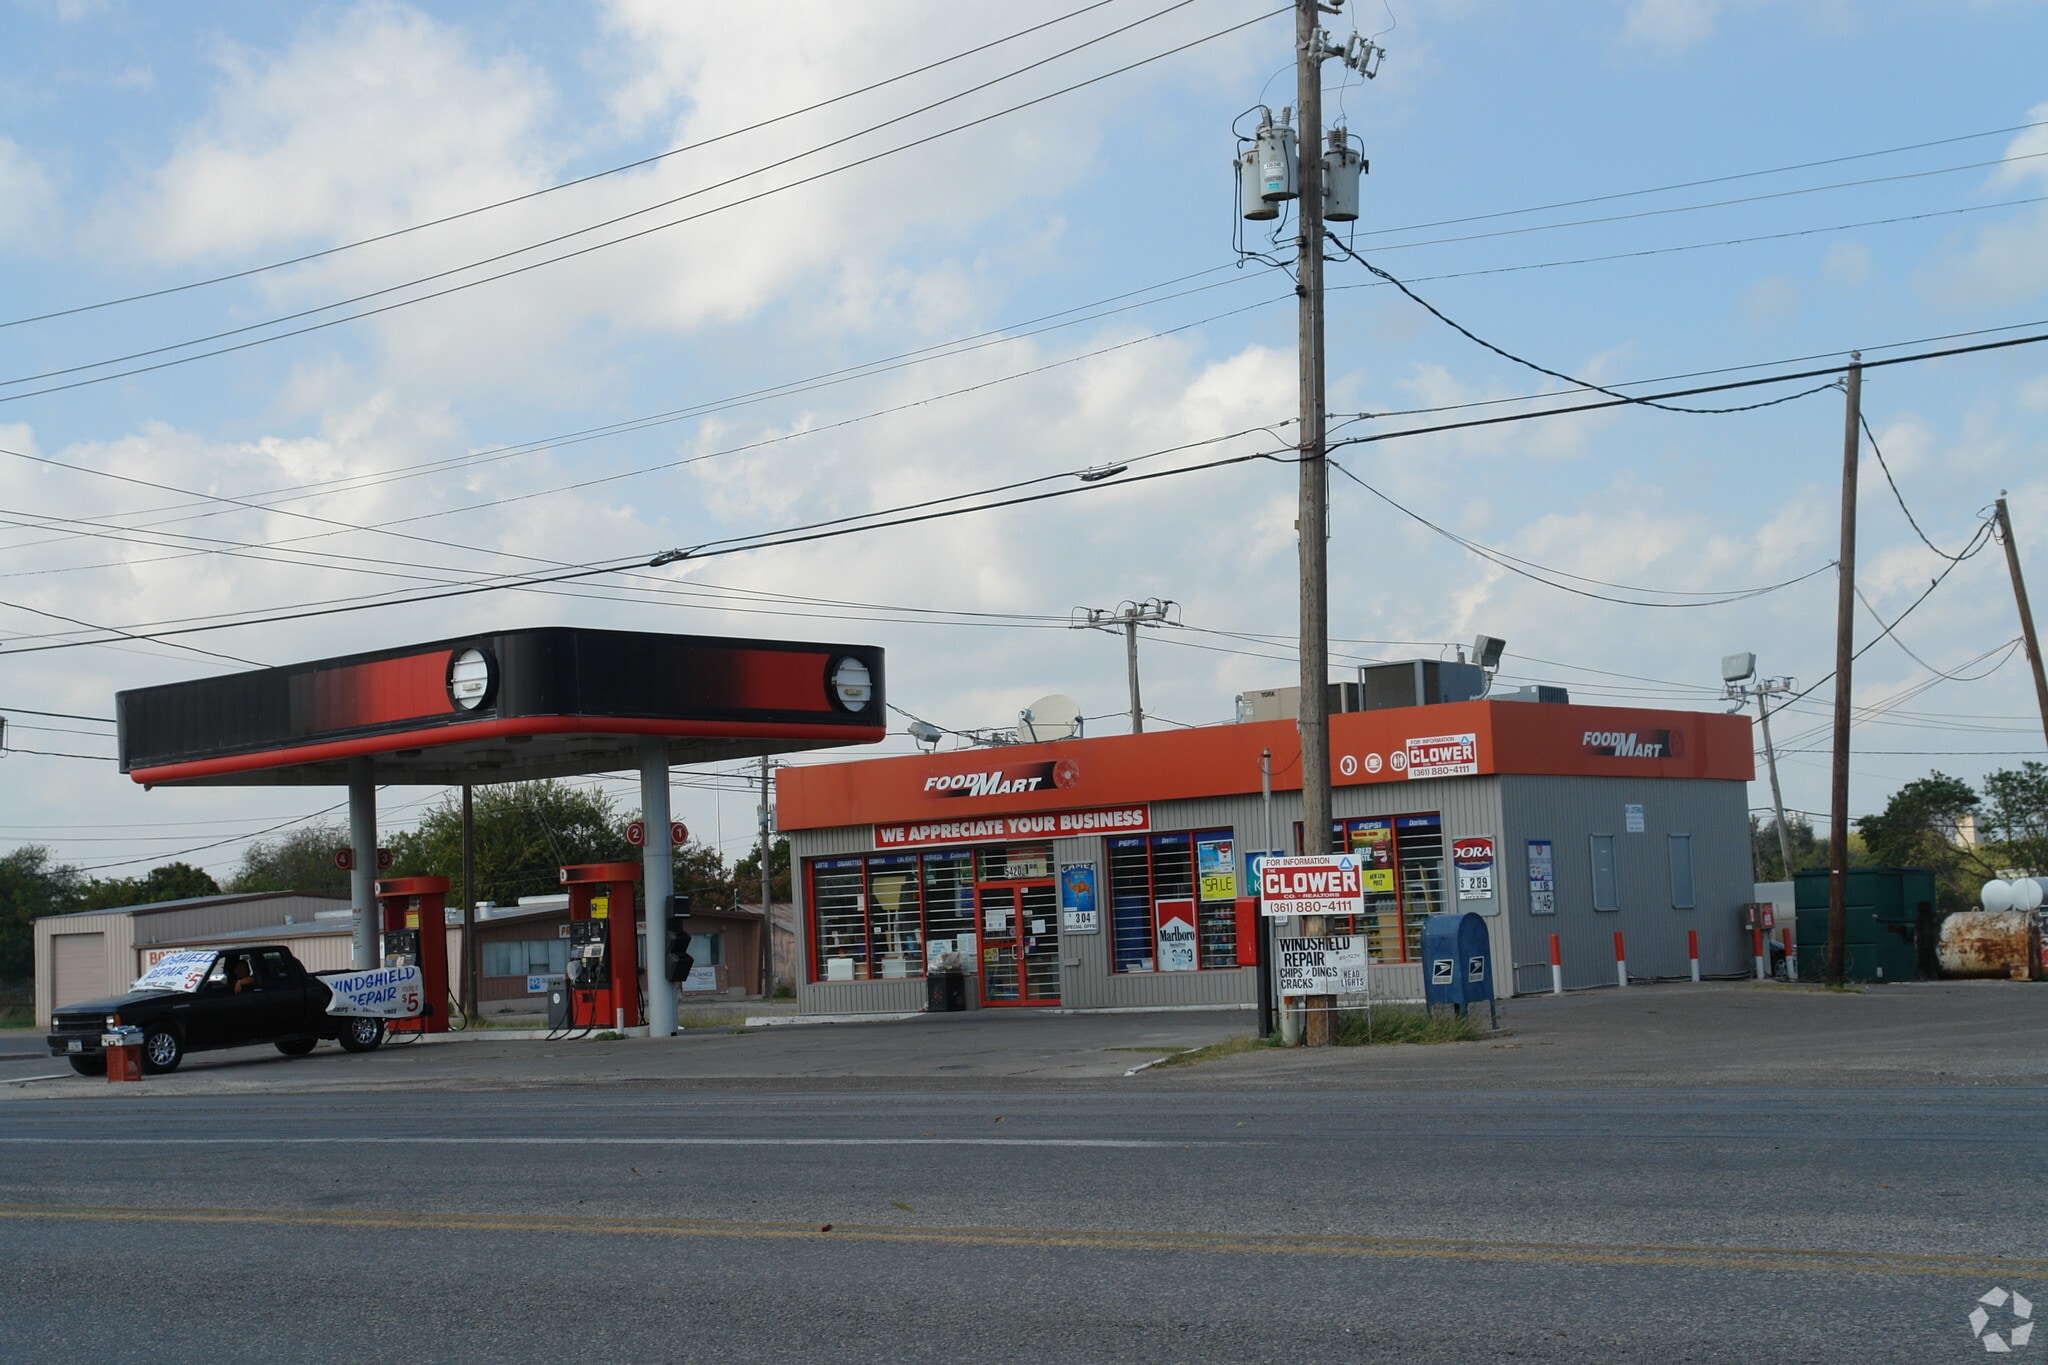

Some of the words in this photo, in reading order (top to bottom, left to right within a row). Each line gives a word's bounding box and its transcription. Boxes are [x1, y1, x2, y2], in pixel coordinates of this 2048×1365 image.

[1410, 745, 1474, 764] CLOWER
[1413, 768, 1430, 777] (361)
[1431, 765, 1470, 776] 880-4111
[880, 828, 905, 843] WE
[908, 819, 1004, 842] APPRECIATE
[1007, 815, 1057, 834] YOUR
[1060, 809, 1143, 831] BUSINESS
[1358, 822, 1382, 830] PEPSI
[632, 828, 640, 839] 2
[676, 828, 682, 838] 1
[1118, 839, 1139, 847] PEPSI
[923, 853, 943, 861] CERVEZA
[1453, 846, 1494, 858] DORA
[815, 861, 829, 869] LOTTO
[1266, 859, 1281, 867] FOR
[1283, 857, 1330, 866] INFORMATION
[1265, 871, 1358, 894] CLOWER
[1270, 901, 1293, 913] (361)
[1296, 900, 1352, 913] 880-4111
[1160, 926, 1195, 942] Marlboro
[1280, 937, 1350, 953] WINDSHIELD
[1284, 952, 1325, 967] REPAIR
[1280, 968, 1303, 978] CHIPS
[1312, 966, 1338, 978] DINGS
[1343, 970, 1360, 978] HEAD
[184, 973, 203, 990] $5
[1281, 978, 1314, 989] CRACKS
[1341, 978, 1364, 988] LIGHTS
[402, 993, 419, 1013] $5
